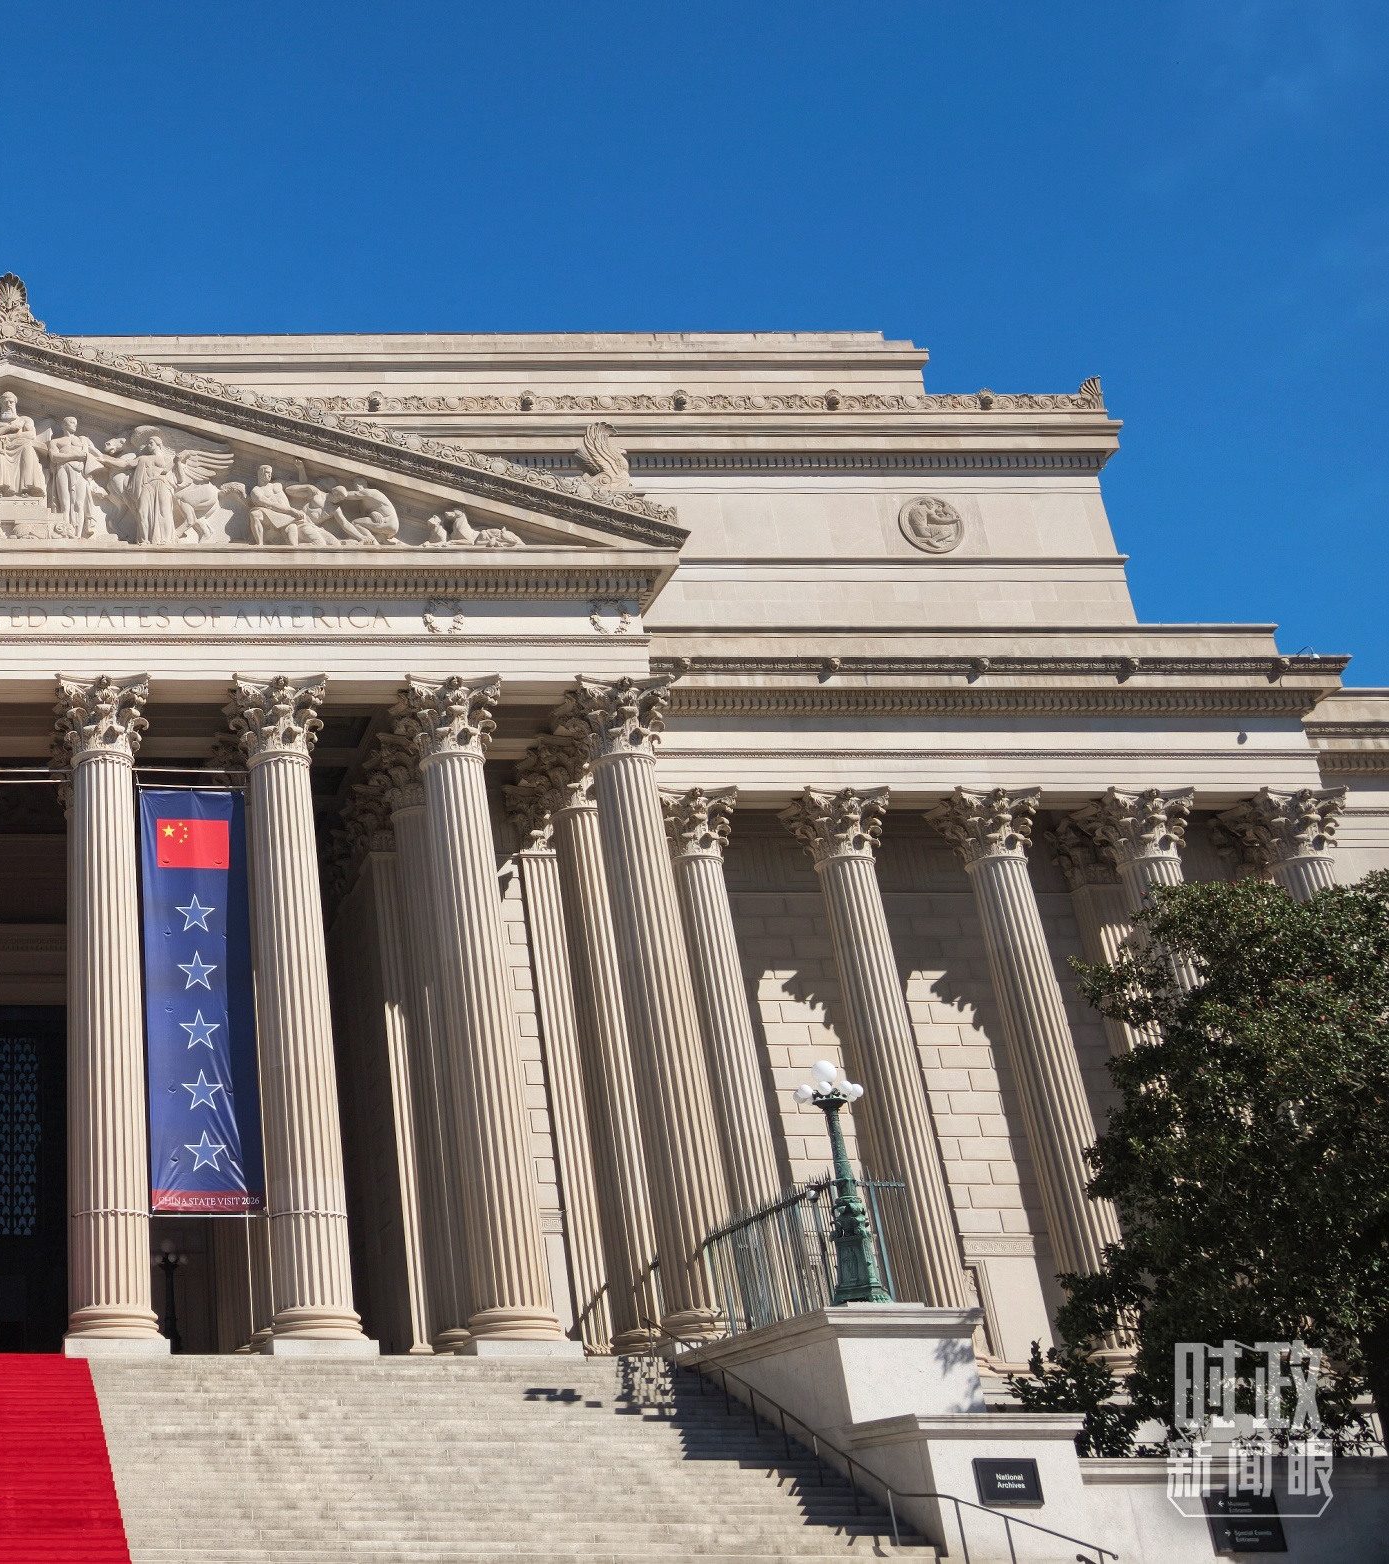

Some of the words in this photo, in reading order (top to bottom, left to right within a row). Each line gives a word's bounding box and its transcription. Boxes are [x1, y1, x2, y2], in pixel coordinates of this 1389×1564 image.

[61, 606, 171, 629] STATES
[182, 606, 223, 629] OF
[234, 606, 393, 629] AMERICA
[158, 1196, 187, 1205] CHINA
[188, 1196, 216, 1206] STATE
[217, 1196, 240, 1206] VISIT
[241, 1196, 260, 1205] 2026
[995, 1473, 1024, 1481] National
[997, 1481, 1026, 1489] Archives
